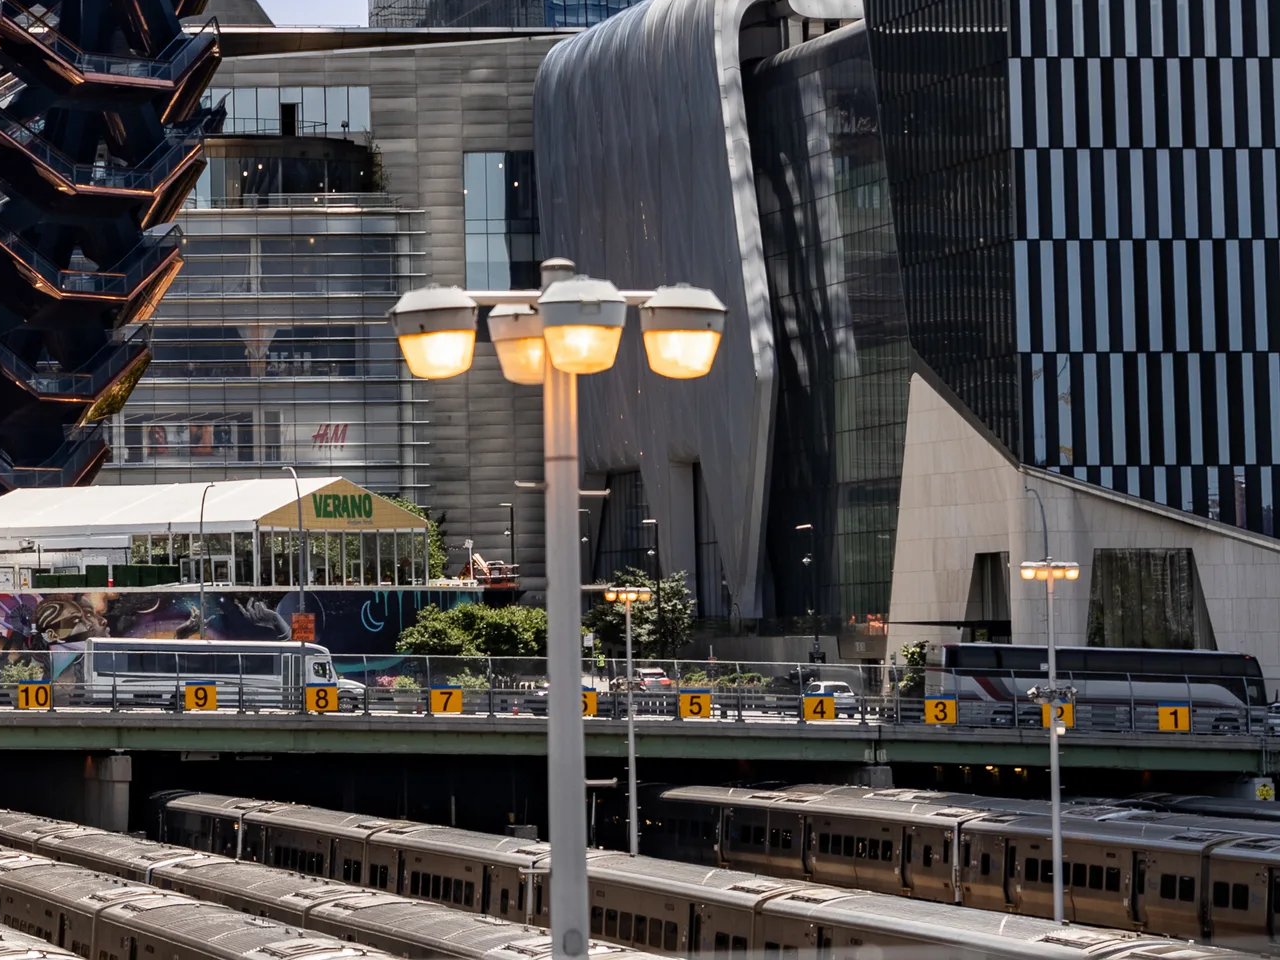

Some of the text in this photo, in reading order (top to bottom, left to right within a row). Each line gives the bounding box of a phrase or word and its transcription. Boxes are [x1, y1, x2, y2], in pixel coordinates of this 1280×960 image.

[311, 423, 349, 449] H&M
[312, 493, 373, 519] VERANO
[21, 686, 48, 706] 10
[195, 687, 207, 707] 9
[316, 689, 328, 709] 8
[440, 692, 452, 711] 7
[690, 696, 702, 715] 5
[813, 699, 826, 718] 4
[935, 702, 947, 721] 3
[1170, 710, 1178, 728] 1
